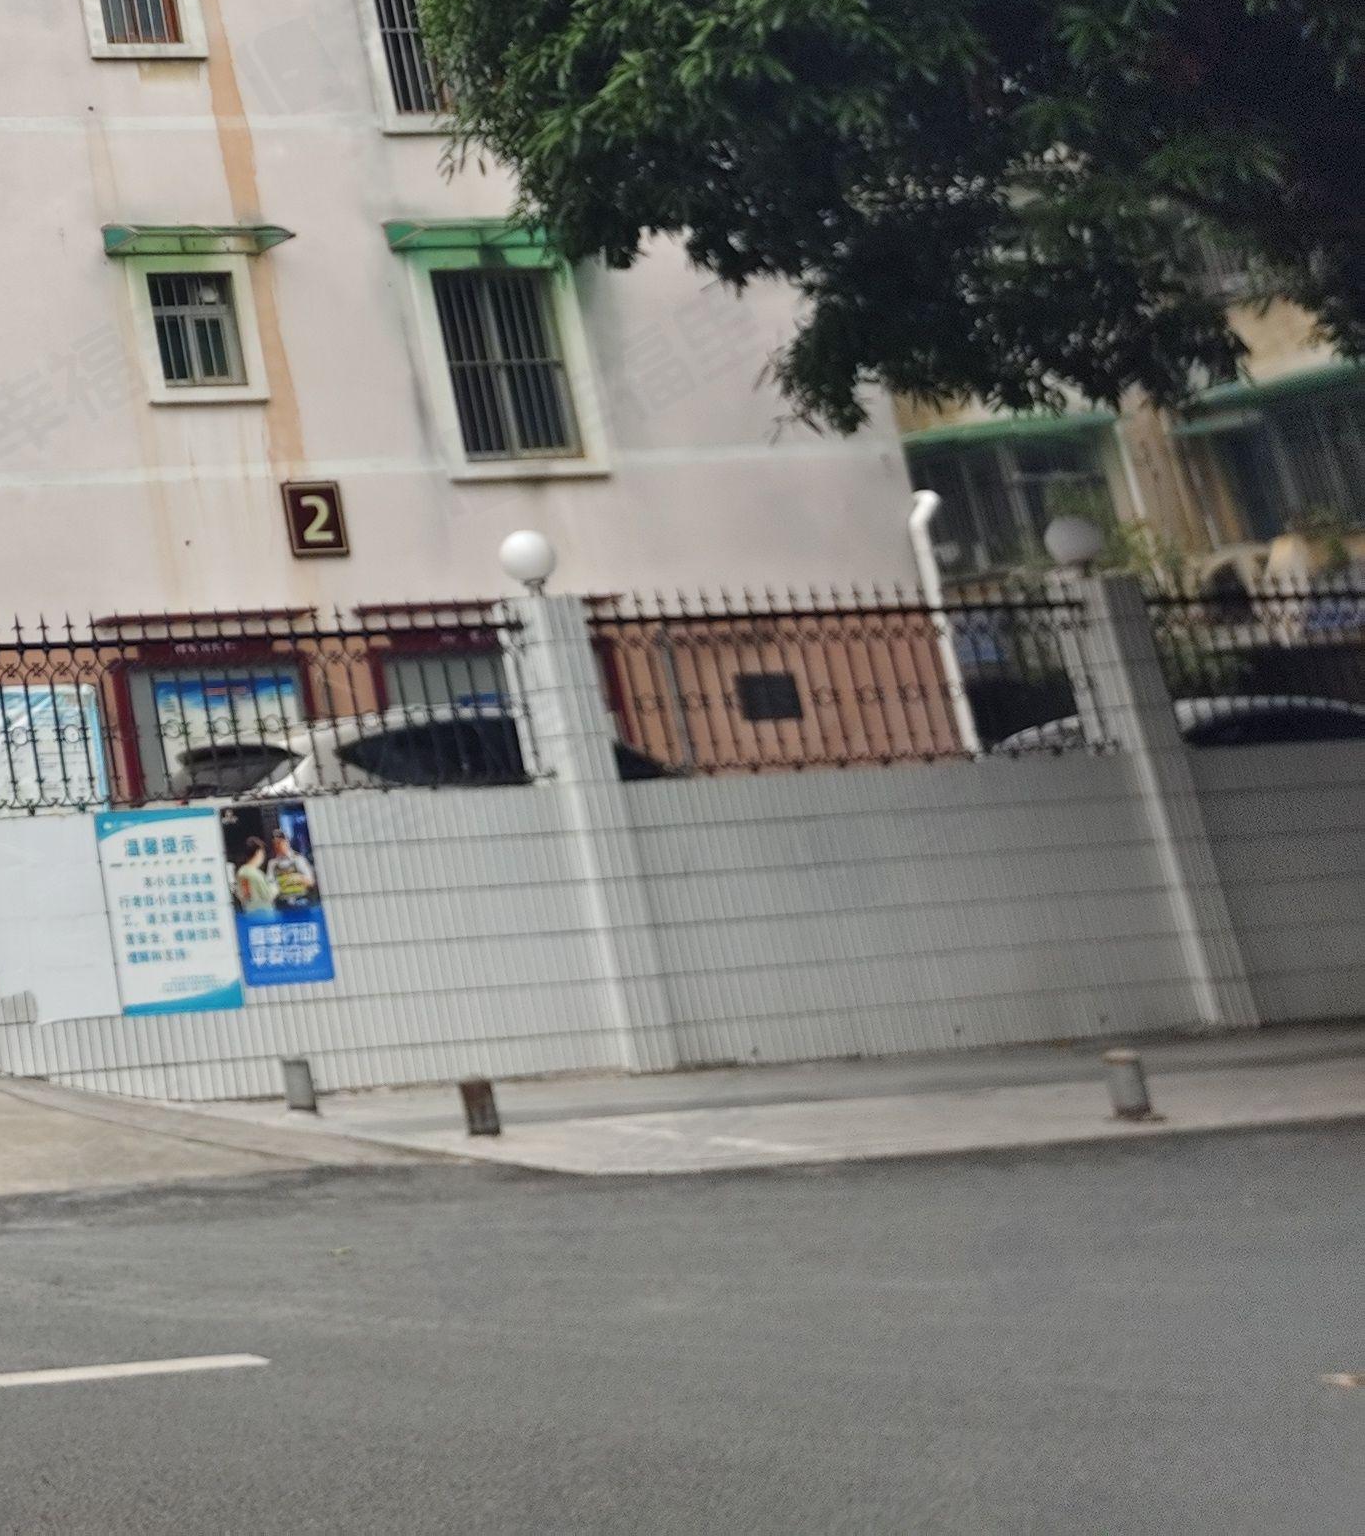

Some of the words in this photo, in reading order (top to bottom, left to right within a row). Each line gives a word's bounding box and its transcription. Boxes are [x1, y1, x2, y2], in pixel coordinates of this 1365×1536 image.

[300, 495, 335, 542] 2
[125, 835, 197, 857] 温馨提示
